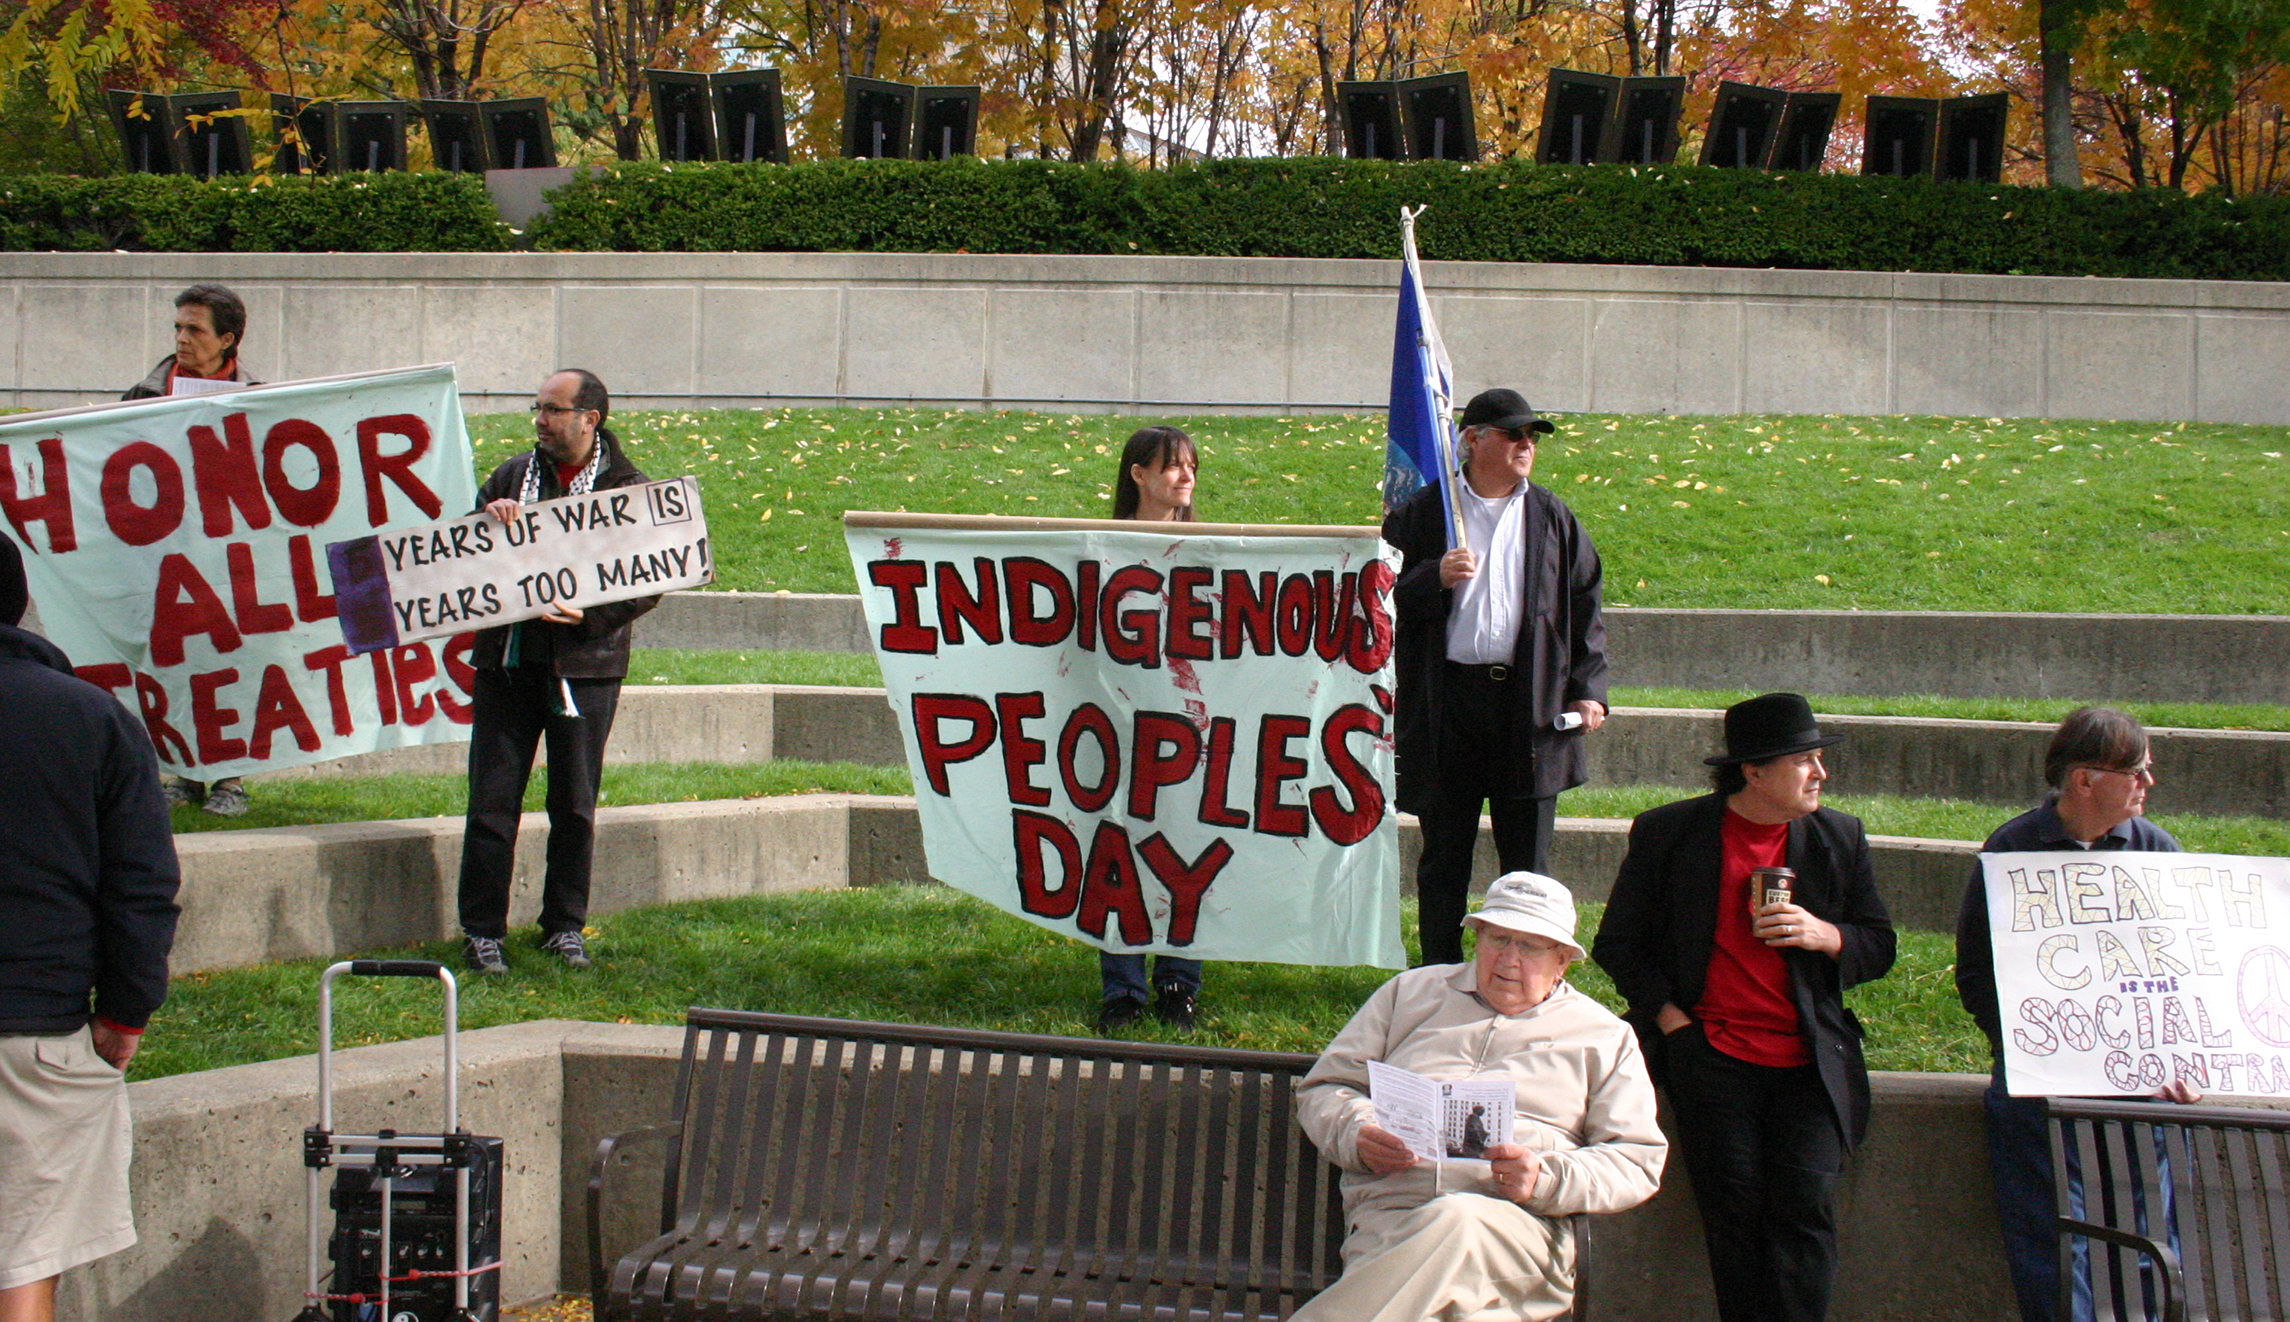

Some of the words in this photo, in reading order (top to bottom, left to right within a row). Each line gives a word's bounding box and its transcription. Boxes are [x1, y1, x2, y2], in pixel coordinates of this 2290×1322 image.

[0, 413, 442, 554] HONOR
[384, 520, 494, 572] YEARS
[504, 511, 541, 547] OF
[551, 493, 637, 533] WAR
[653, 485, 685, 519] IS
[150, 534, 339, 668] ALL
[394, 582, 502, 632] YEARS
[517, 567, 577, 607] TOO
[599, 537, 713, 592] MANY!
[868, 556, 1397, 675] INDIGENOUS
[1012, 808, 1234, 946] DAY
[2008, 862, 2267, 932] HEALTH
[2036, 926, 2223, 990] CARE
[2120, 981, 2138, 993] IS
[2143, 976, 2179, 993] THE
[2013, 995, 2232, 1056] SOCIAL
